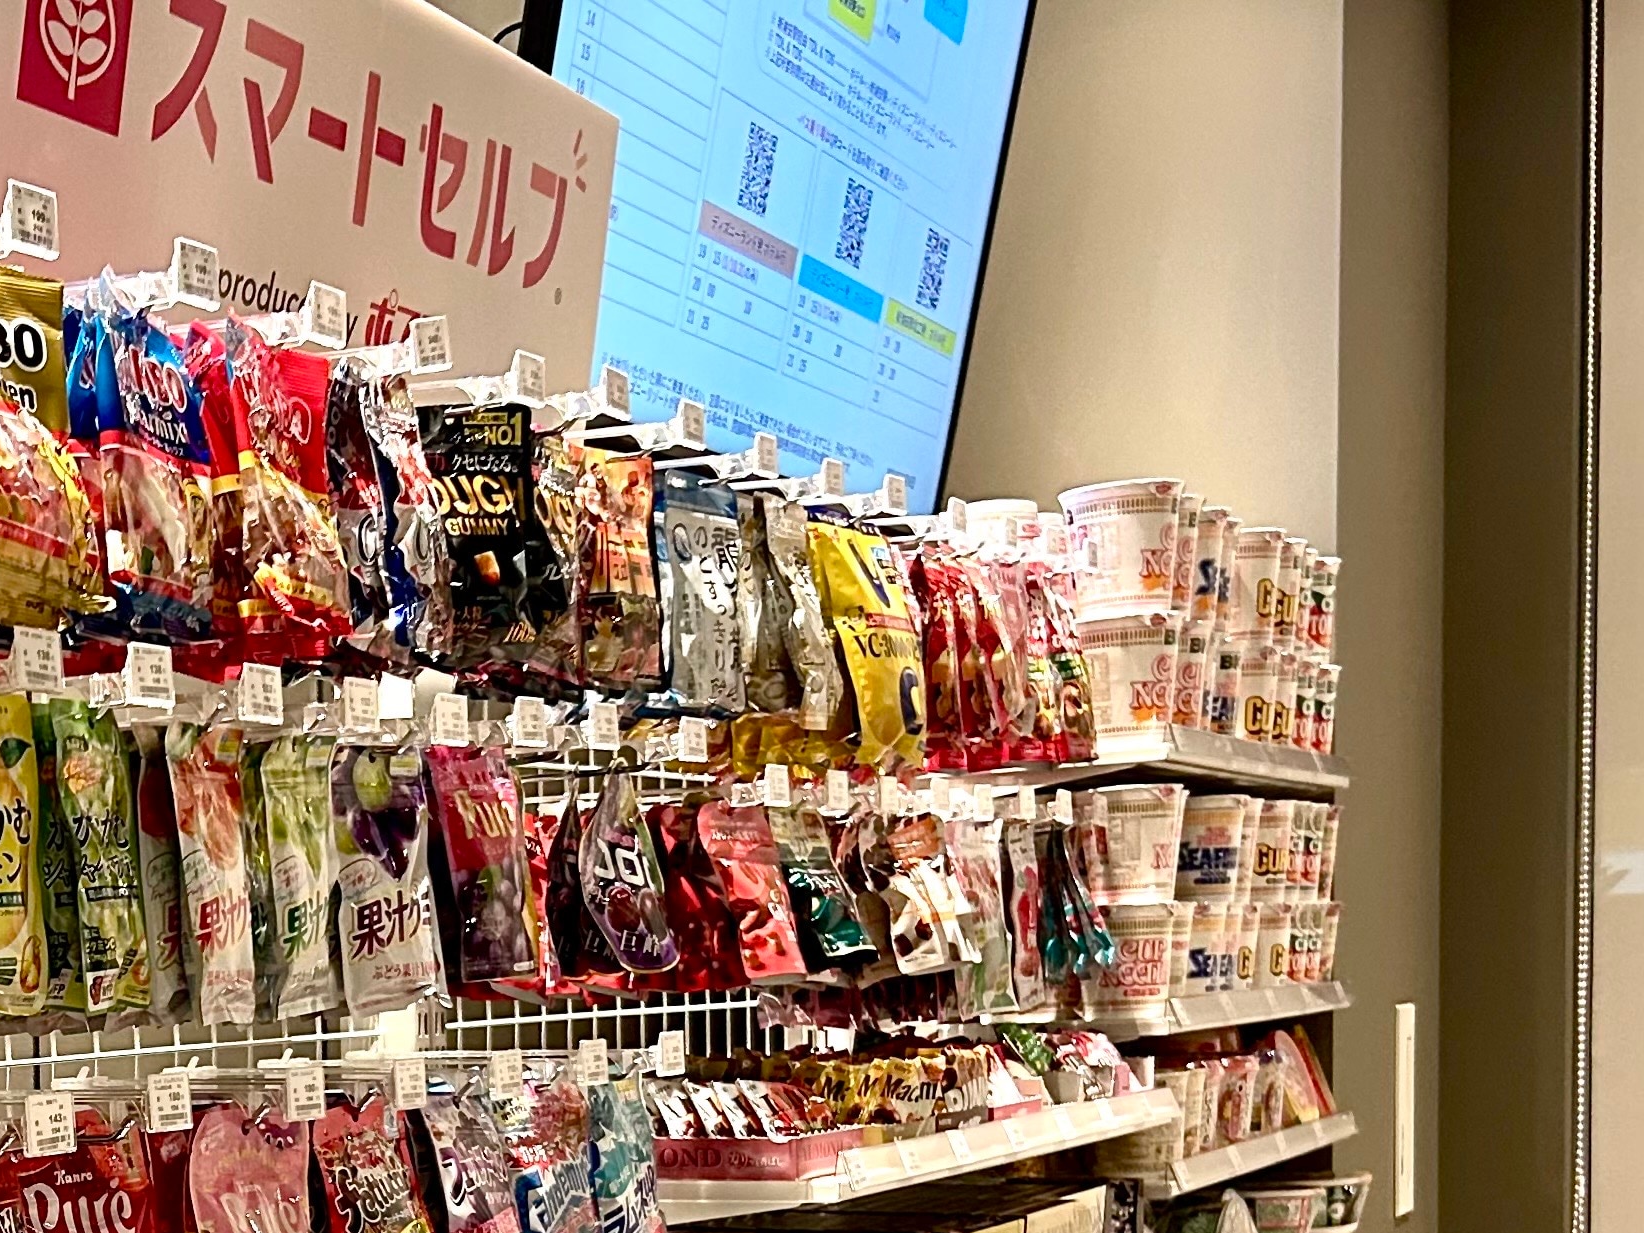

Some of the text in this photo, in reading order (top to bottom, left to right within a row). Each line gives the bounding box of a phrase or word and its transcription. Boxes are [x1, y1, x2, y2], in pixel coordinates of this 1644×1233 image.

[150, 0, 568, 289] スマートセルフ
[445, 518, 508, 537] GUMMY
[660, 1148, 722, 1169] OND
[54, 1169, 94, 1186] Kanro
